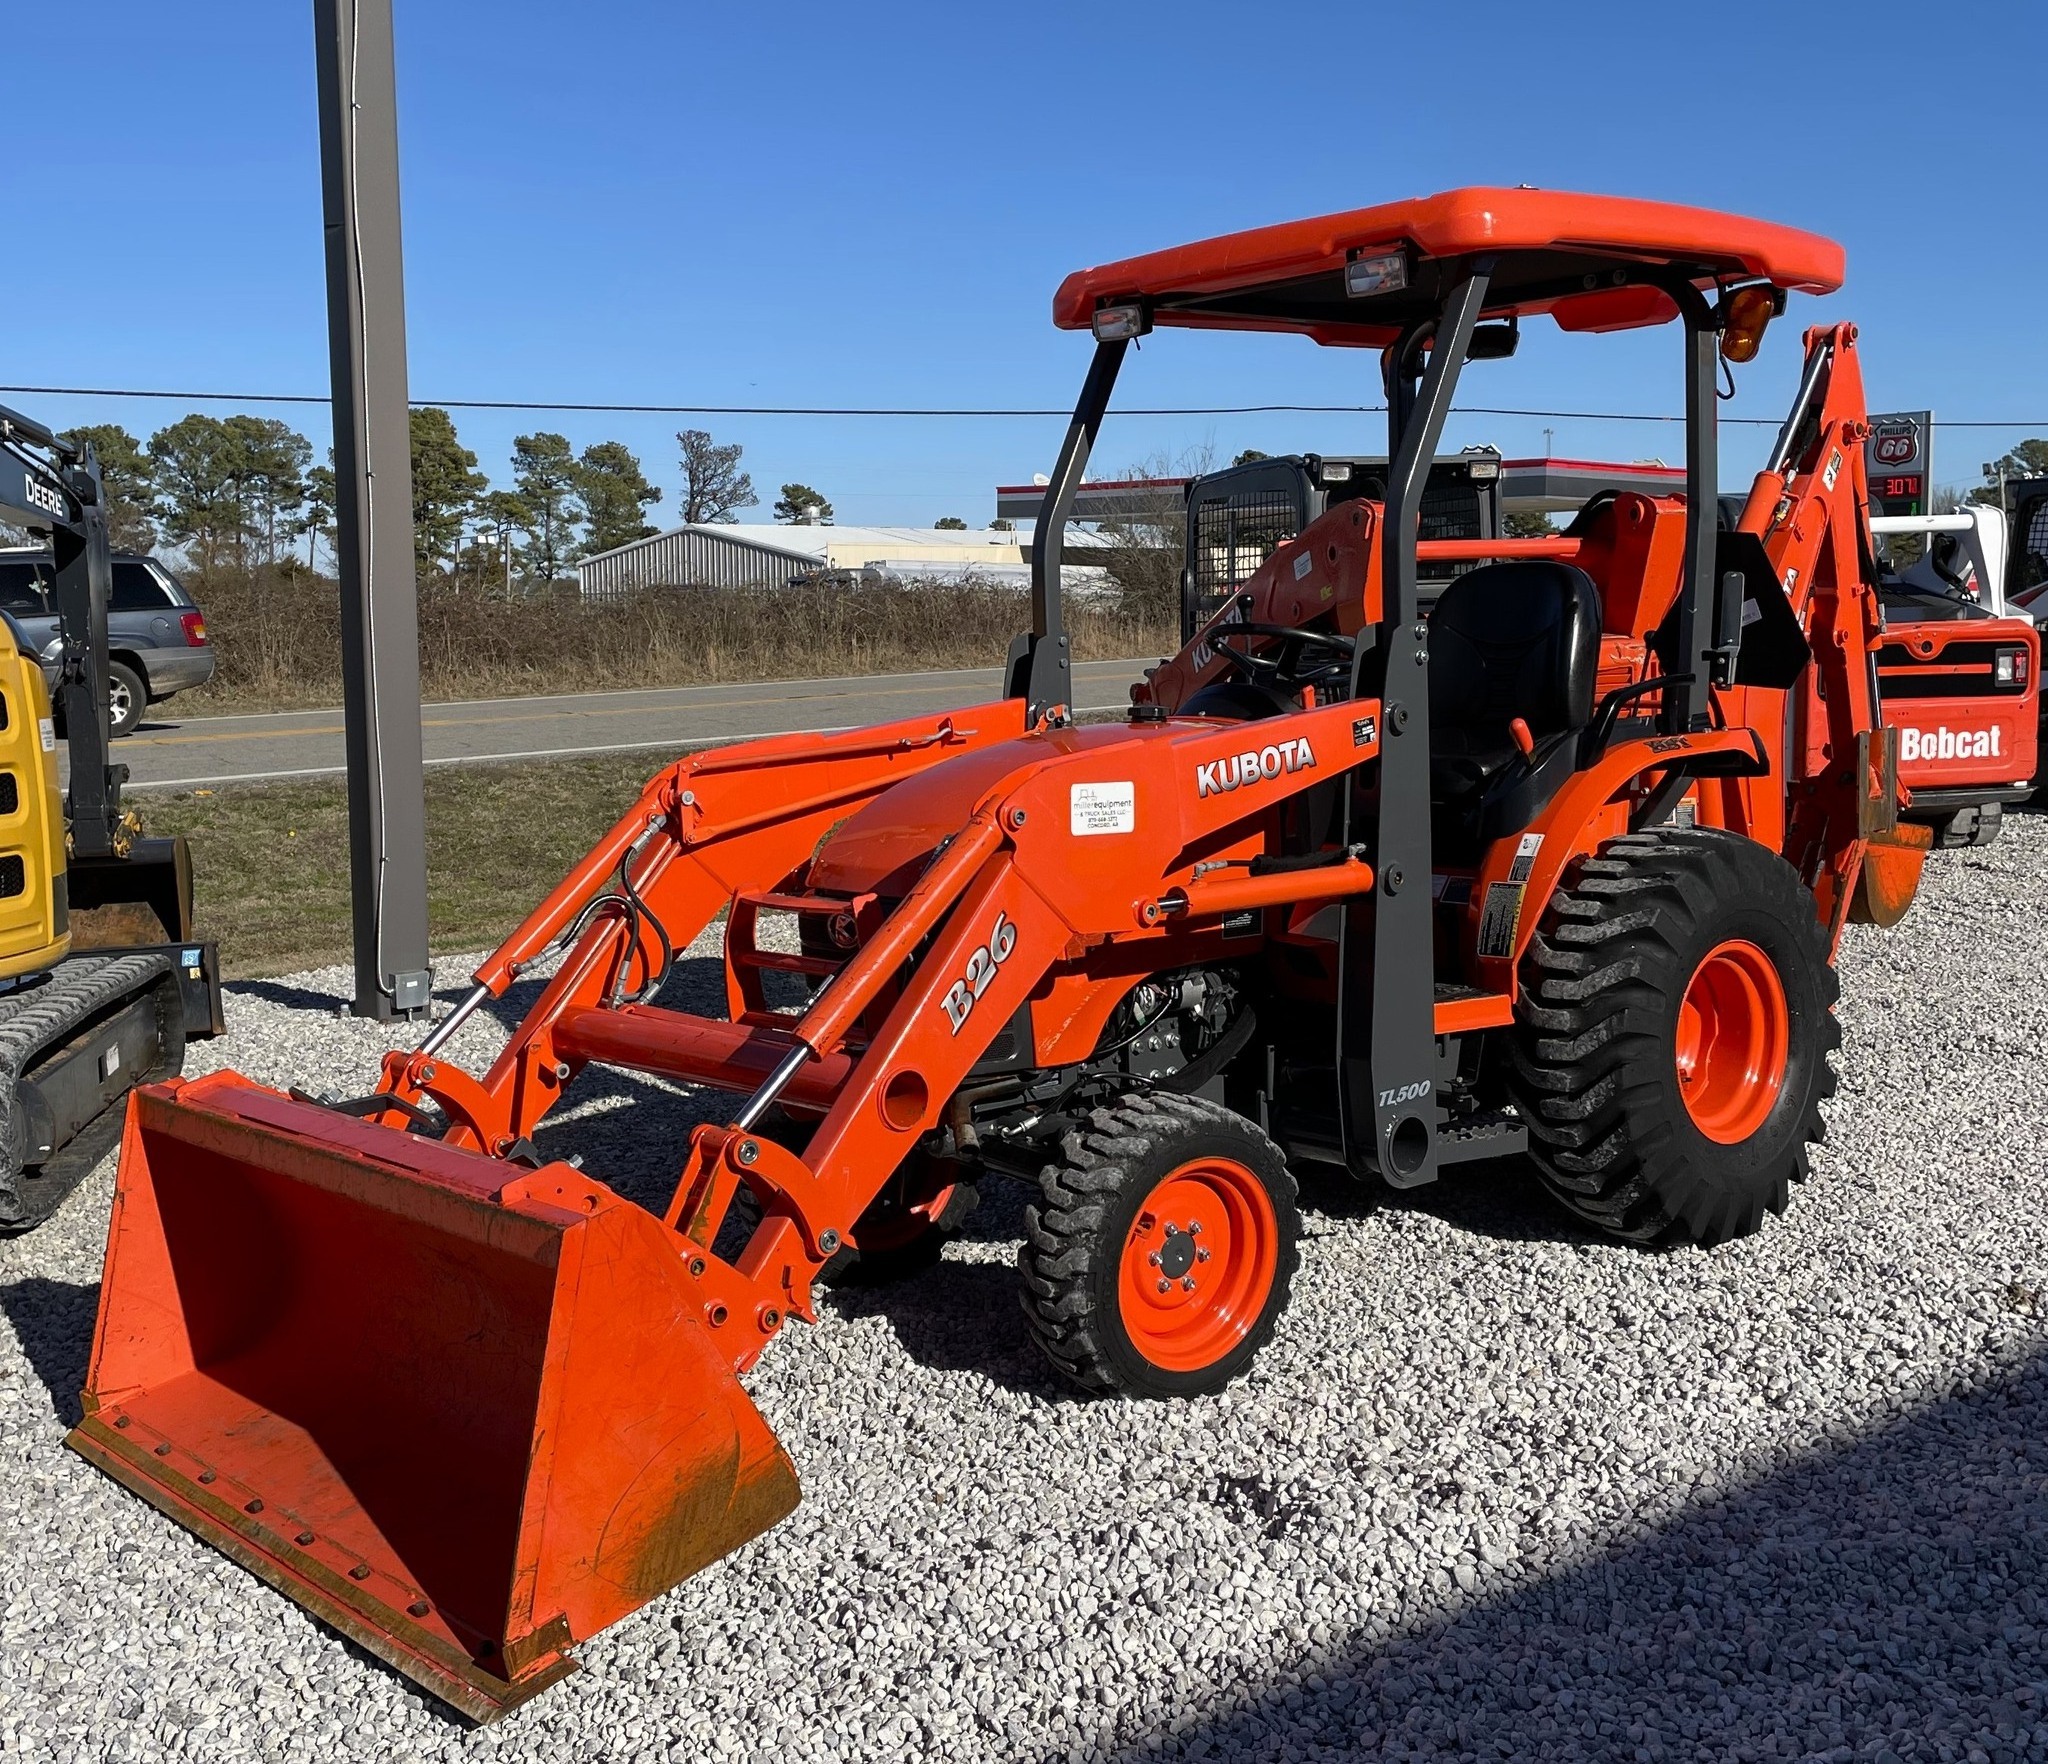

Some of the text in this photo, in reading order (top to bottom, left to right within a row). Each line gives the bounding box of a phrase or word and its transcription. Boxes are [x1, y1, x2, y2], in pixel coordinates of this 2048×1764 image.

[1880, 427, 1911, 436] PHILLIPS
[1881, 438, 1909, 457] 66
[25, 473, 63, 517] DEERE
[1901, 725, 2000, 761] Bobcat
[1197, 736, 1316, 798] KUBOTA
[941, 911, 1017, 1036] B26
[1379, 1080, 1431, 1107] TL500
